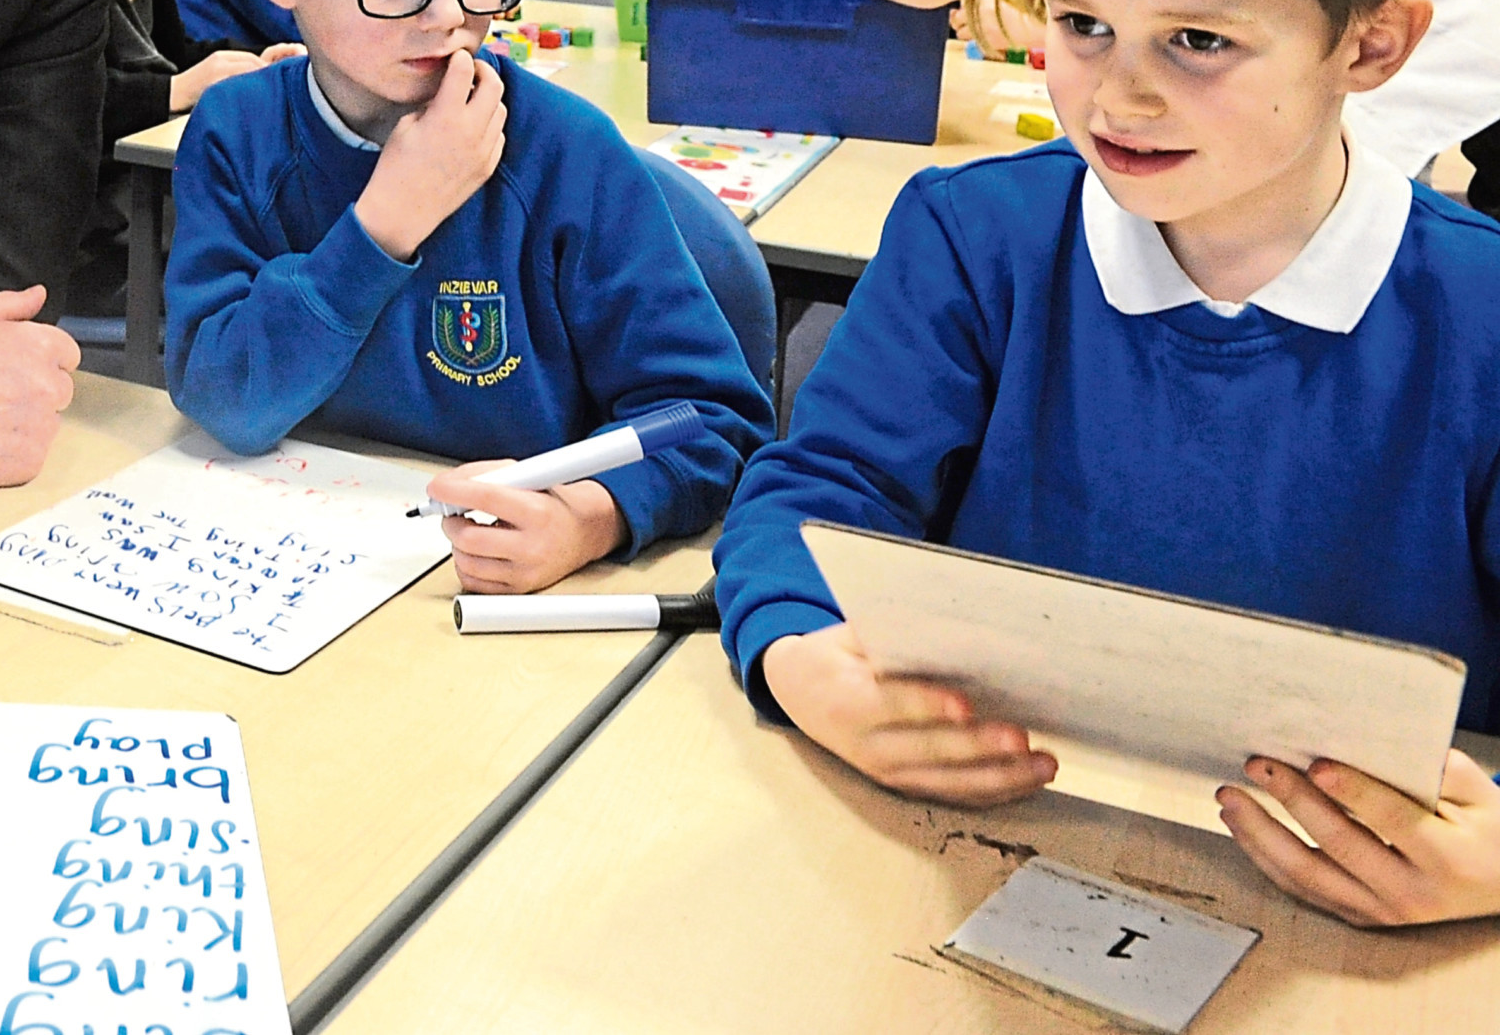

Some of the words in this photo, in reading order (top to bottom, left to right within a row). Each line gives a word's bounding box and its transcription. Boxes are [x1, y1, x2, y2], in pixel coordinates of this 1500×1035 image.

[439, 280, 499, 295] INZIEVAR
[426, 350, 472, 386] PRIMARY
[476, 355, 522, 387] SCHOOL
[28, 743, 231, 804] bring
[52, 839, 246, 899] thing
[28, 937, 248, 1007] ring
